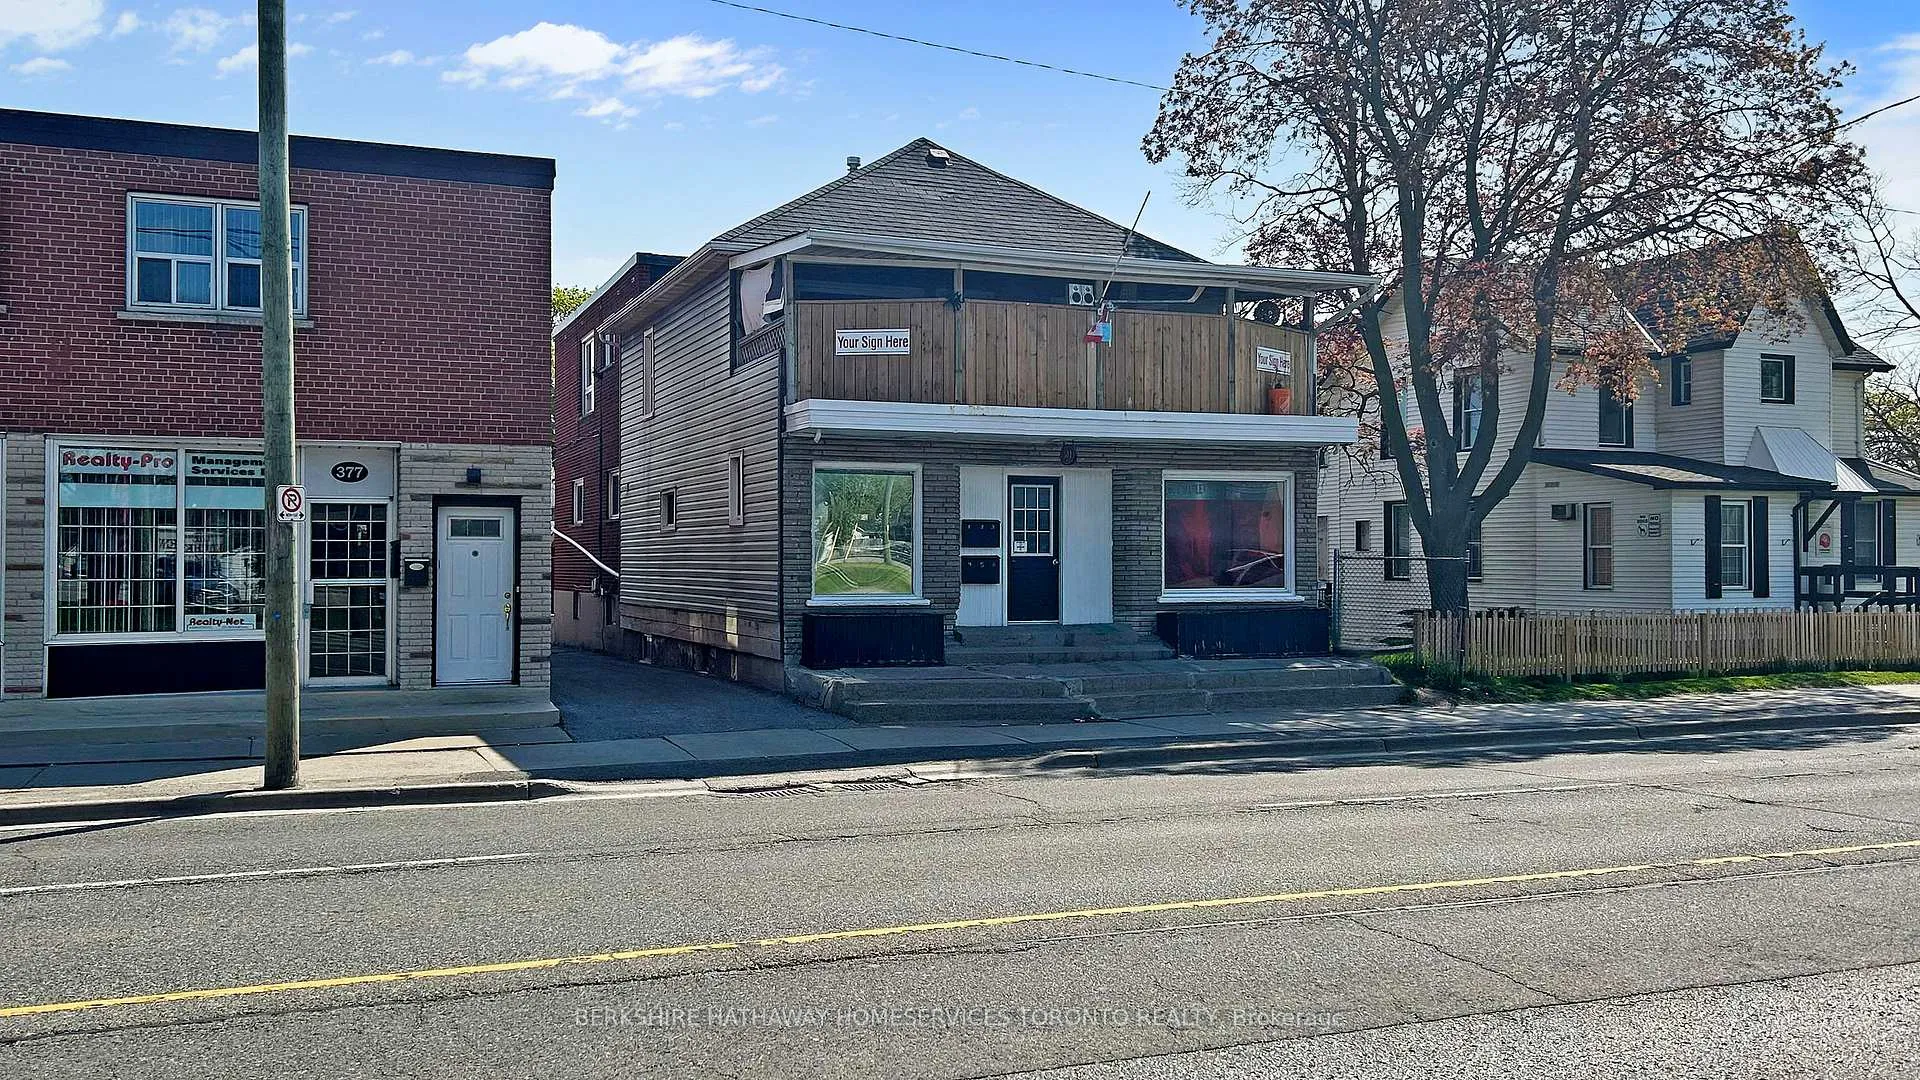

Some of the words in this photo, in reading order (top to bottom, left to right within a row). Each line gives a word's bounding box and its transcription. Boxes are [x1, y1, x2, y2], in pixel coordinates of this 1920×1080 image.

[837, 336, 859, 348] Your
[861, 336, 882, 350] Sign
[885, 335, 908, 348] Here
[62, 451, 174, 471] Realty-Pro
[192, 456, 265, 467] Managem
[192, 466, 255, 476] Services
[336, 466, 363, 478] 377
